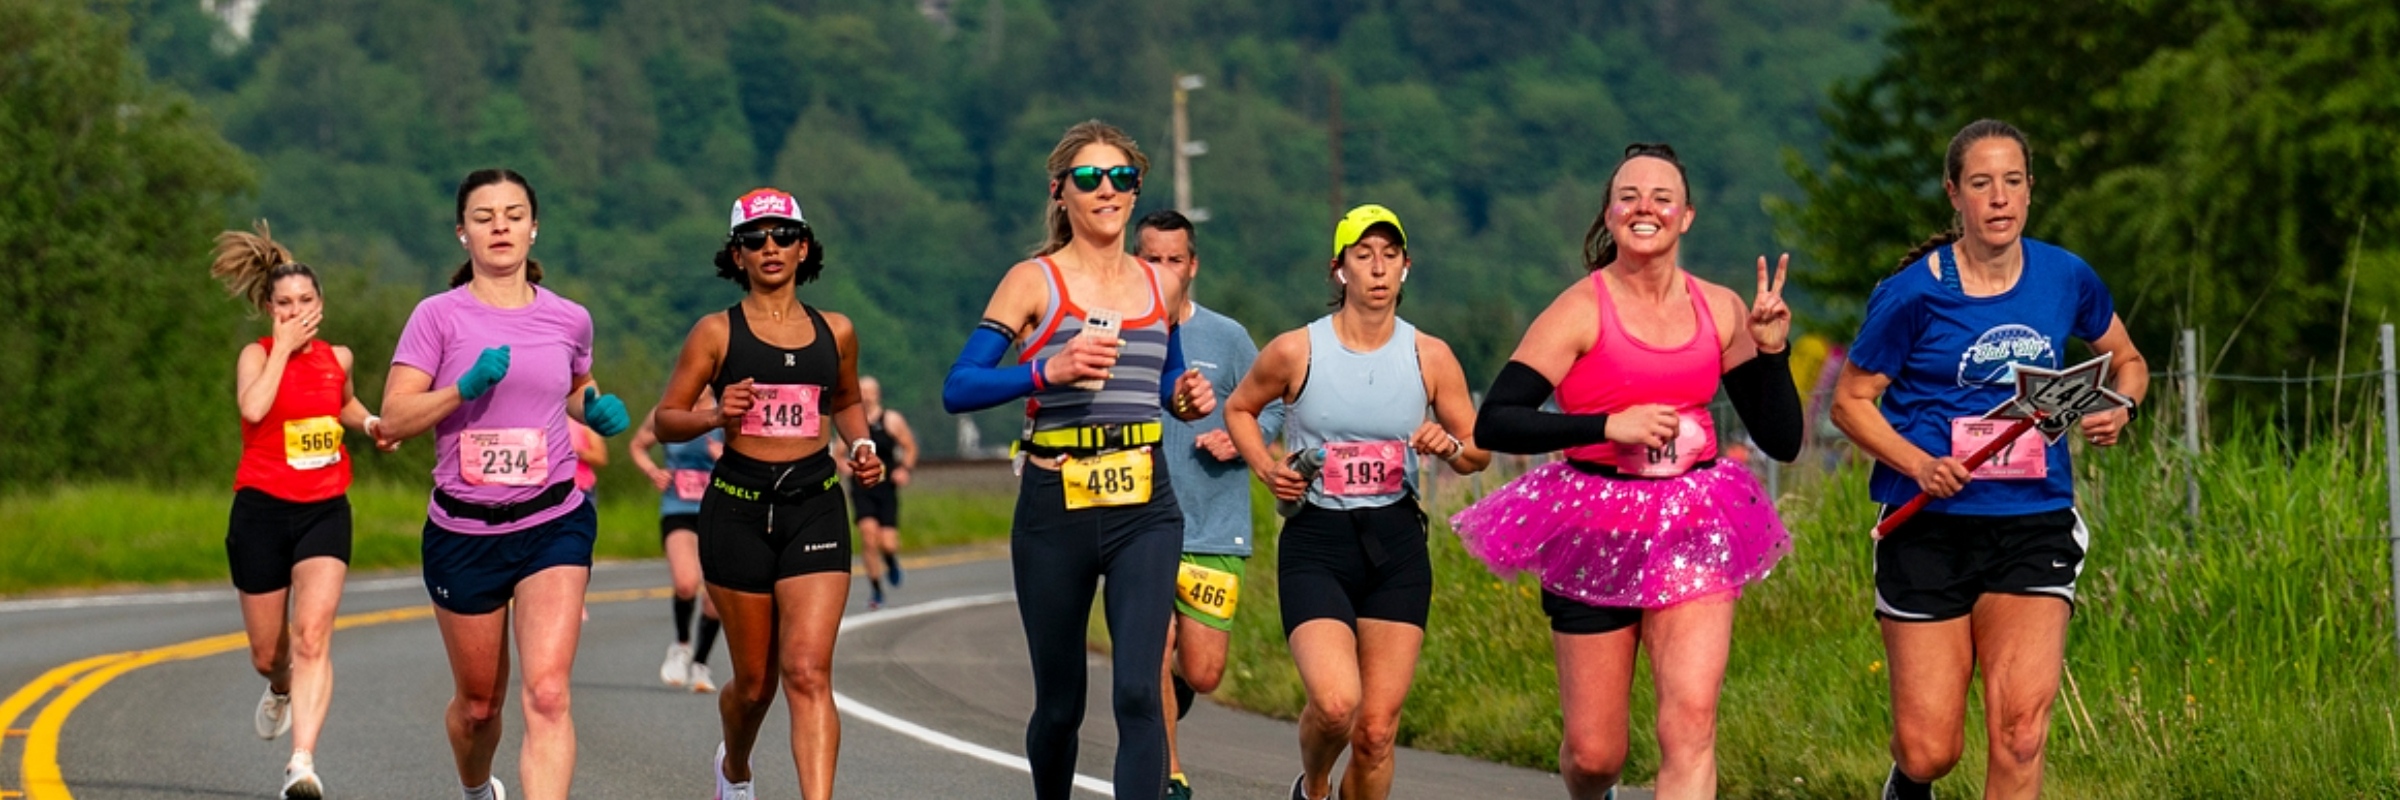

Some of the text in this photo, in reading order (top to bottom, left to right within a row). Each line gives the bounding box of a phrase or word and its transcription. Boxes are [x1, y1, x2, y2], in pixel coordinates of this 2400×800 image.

[762, 403, 803, 427] 148
[301, 431, 333, 451] 566
[482, 448, 529, 475] 234
[1344, 461, 1386, 485] 193
[1087, 466, 1135, 495] 485
[1189, 582, 1227, 608] 466
